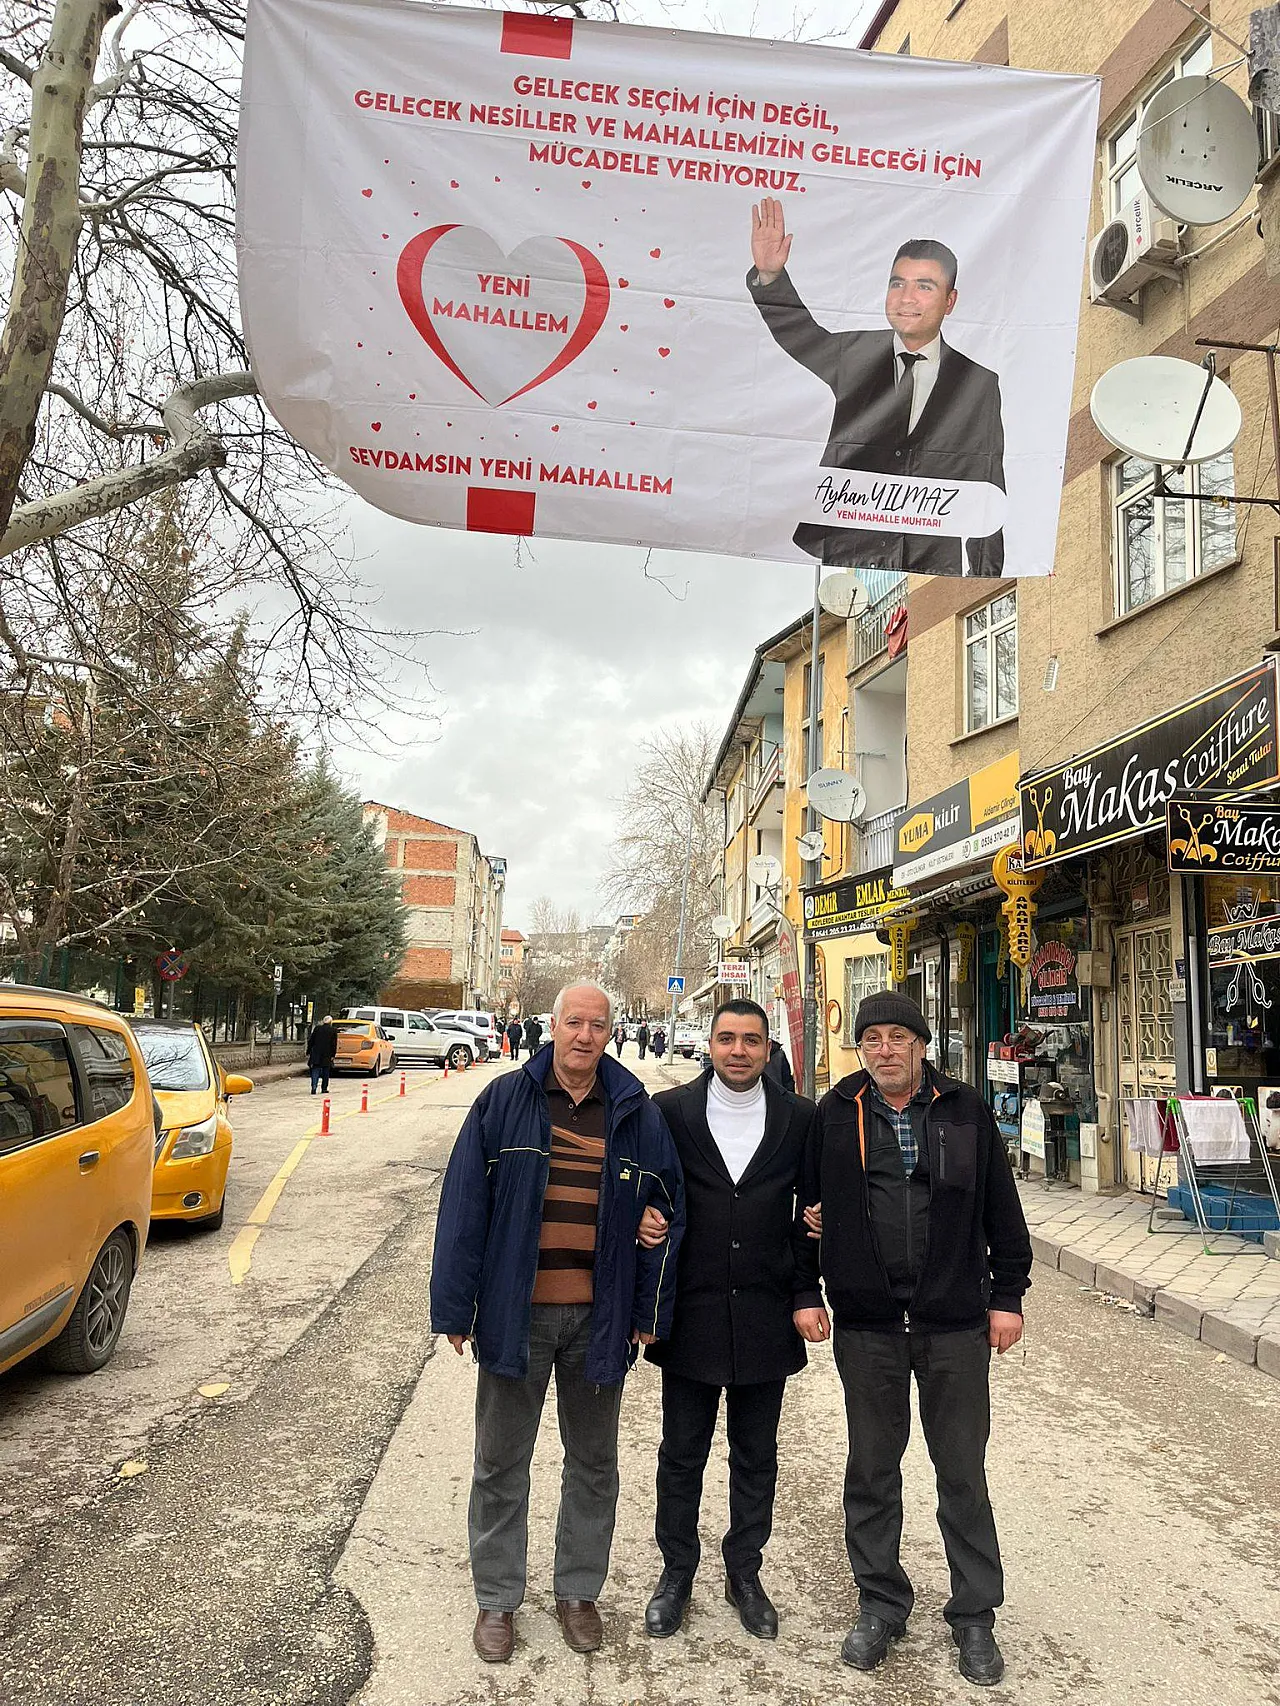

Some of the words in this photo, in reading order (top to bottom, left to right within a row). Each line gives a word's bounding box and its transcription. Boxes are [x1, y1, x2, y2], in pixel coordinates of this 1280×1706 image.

[513, 76, 621, 106] GELECEK
[627, 86, 700, 116] SEÇİM
[706, 91, 756, 122] İÇİN
[762, 102, 839, 135] DEĞİL,
[354, 90, 462, 122] GELECEK
[468, 103, 577, 134] NESİLLER
[585, 115, 616, 139] VE
[622, 119, 804, 161] MAHALLEMİZİN
[810, 140, 926, 173] GELECEĞİ
[932, 154, 982, 182] İÇİN
[528, 141, 660, 177] MÜCADELE
[666, 157, 807, 194] VERİYORUZ.
[1165, 174, 1224, 192] ARCELIK
[1133, 199, 1142, 234] arçelik
[477, 272, 531, 298] YENİ
[432, 297, 570, 335] MAHALLEM
[349, 446, 472, 476] SEVDAMSIN
[479, 456, 533, 482] YENİ
[538, 462, 674, 496] MAHALLEM
[815, 475, 870, 514] Ayhan
[869, 480, 960, 516] YILMAZ
[836, 508, 857, 520] YENİ
[858, 512, 900, 524] MAHALLE
[901, 516, 941, 528] MUHTARI
[817, 778, 844, 789] SUNNY
[1059, 753, 1180, 840] Makas
[1183, 696, 1270, 790] Coiffure
[1062, 761, 1095, 791] Bay
[903, 821, 929, 846] YUMA
[934, 803, 961, 832] KİLİT
[1214, 805, 1241, 823] Bay
[814, 891, 838, 917] DEMİR
[855, 878, 886, 907] EMLAK
[1016, 895, 1029, 959] ANAHTARCI
[1208, 934, 1235, 960] Bay
